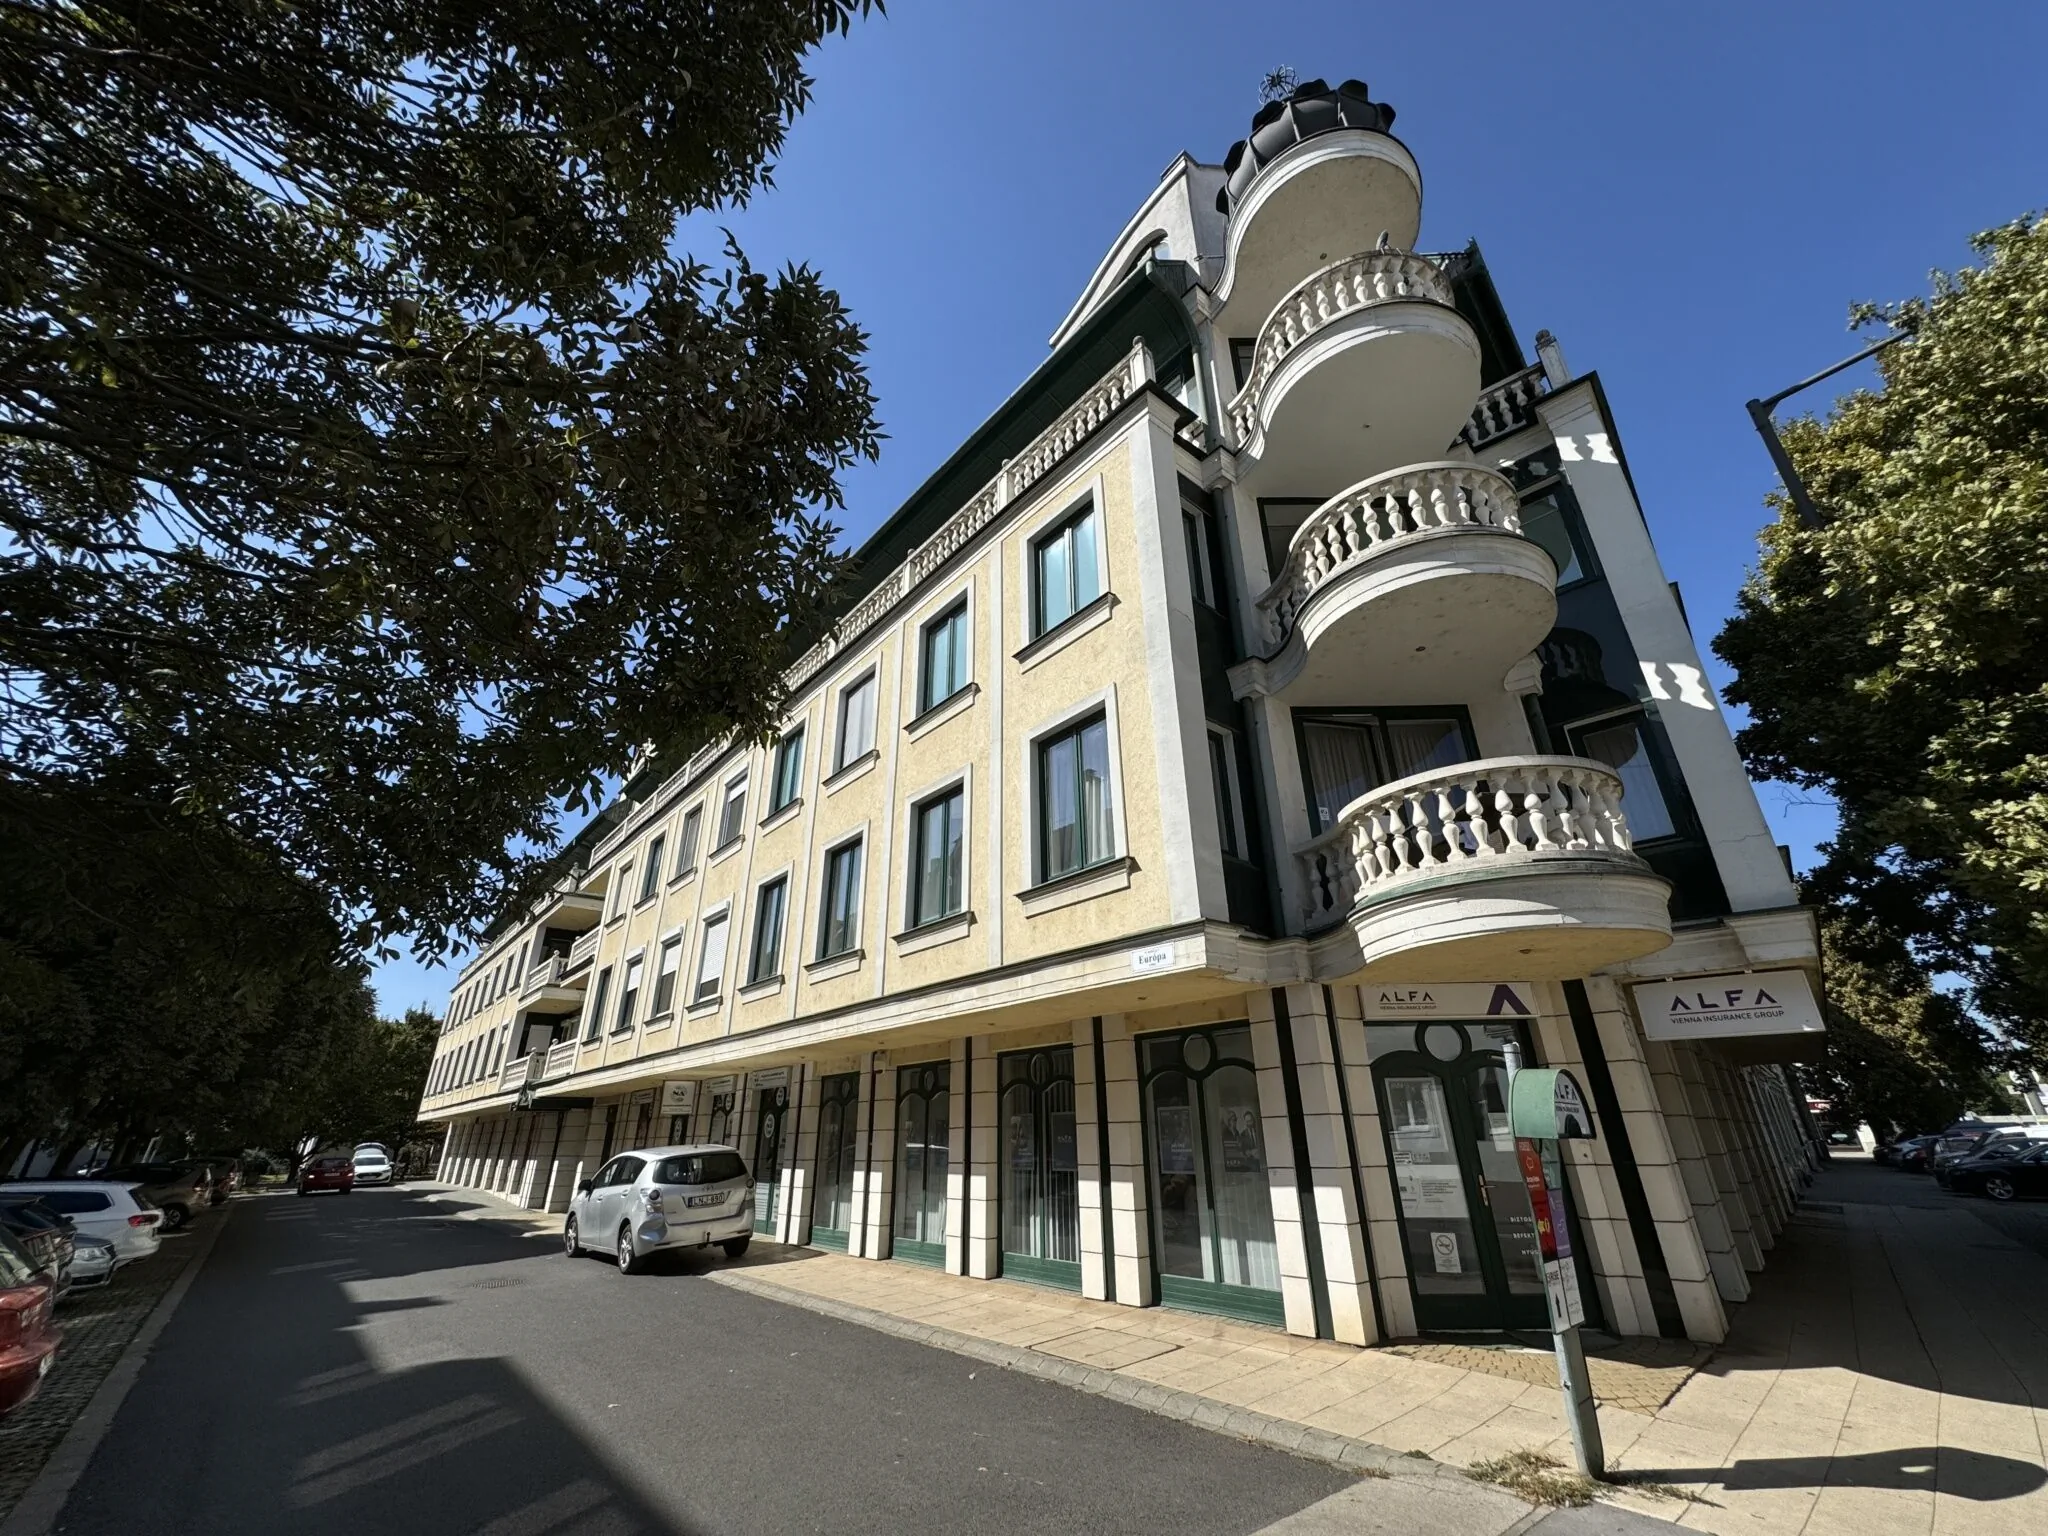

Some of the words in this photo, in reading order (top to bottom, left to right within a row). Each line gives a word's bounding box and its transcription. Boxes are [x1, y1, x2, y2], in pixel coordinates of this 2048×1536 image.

[1380, 991, 1434, 1001] ALFA
[1670, 988, 1778, 1012] ALFA
[1670, 1017, 1702, 1025] VIENNA
[1703, 1013, 1752, 1022] INSURANCE
[1754, 1010, 1785, 1019] GROUP
